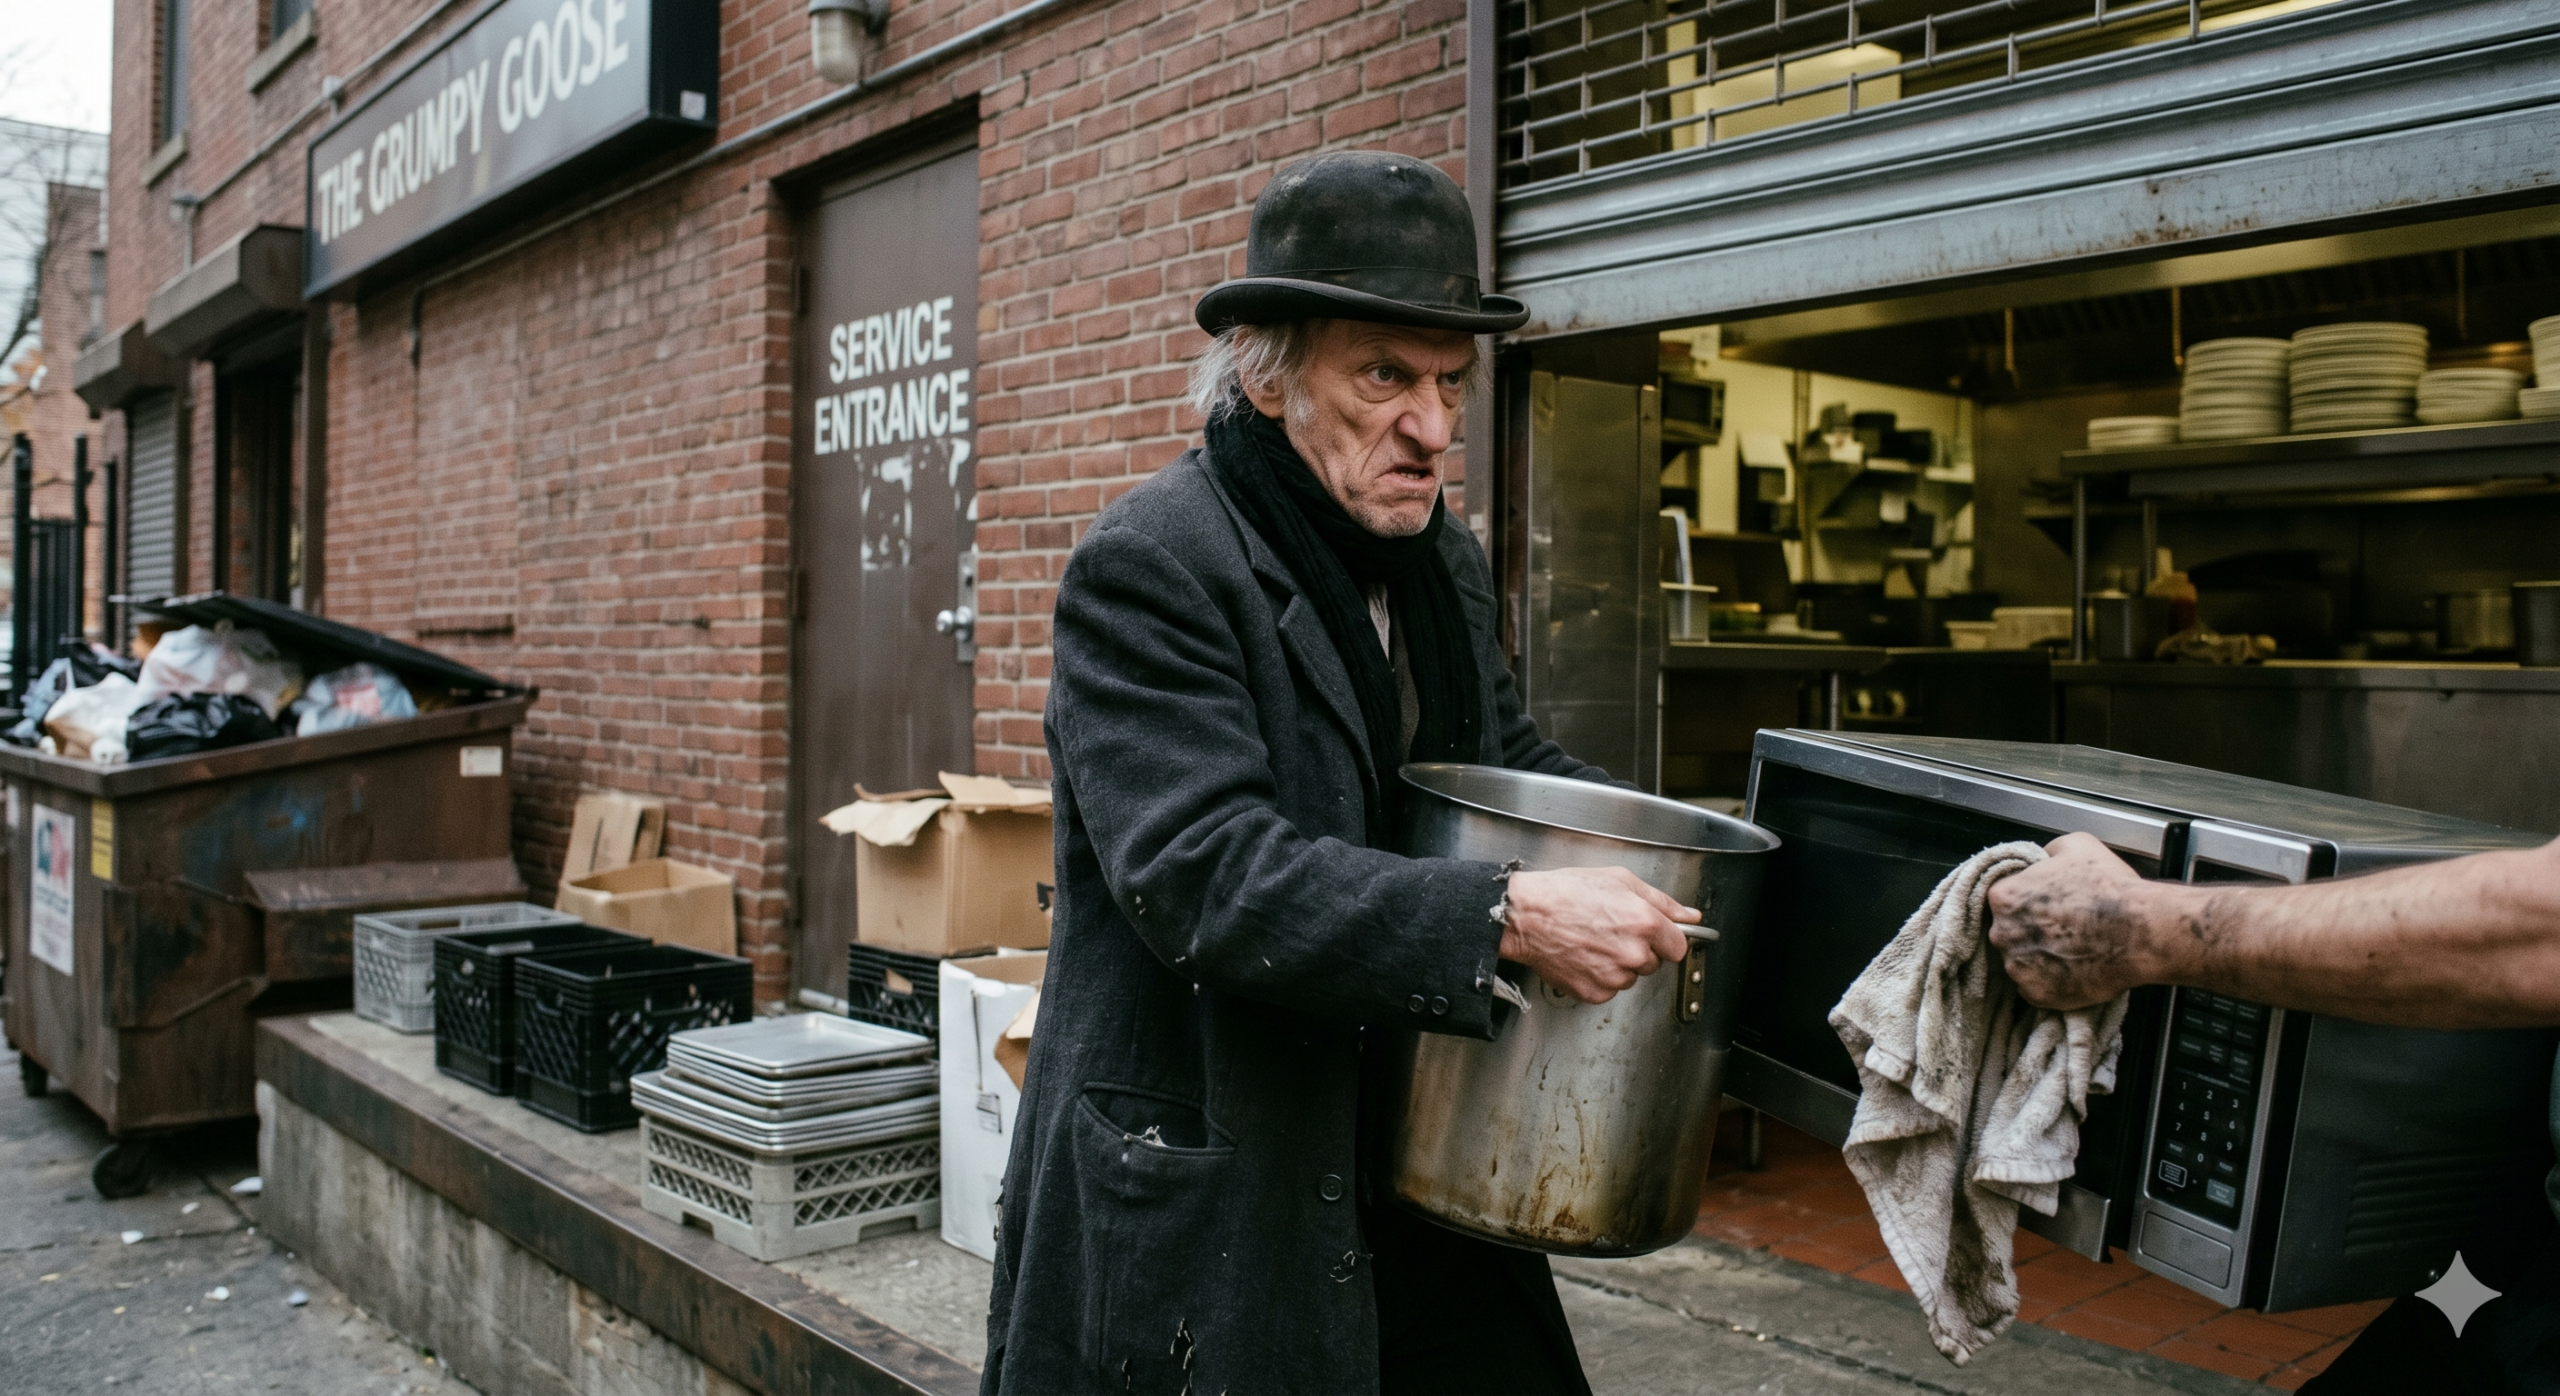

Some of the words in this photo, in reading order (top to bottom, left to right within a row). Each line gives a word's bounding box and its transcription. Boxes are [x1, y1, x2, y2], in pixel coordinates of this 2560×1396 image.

[318, 149, 365, 246] THE
[367, 60, 490, 216] GRUMPY
[498, 0, 629, 135] GOOSE
[829, 295, 954, 384] SERVICE
[814, 368, 970, 456] ENTRANCE
[2182, 1081, 2187, 1090] 1
[2206, 1089, 2213, 1100] 2
[2232, 1098, 2239, 1109] 3
[2178, 1102, 2185, 1111] 4
[2203, 1110, 2210, 1120] 5
[2228, 1120, 2236, 1130] 6
[2175, 1121, 2182, 1132] 7
[2200, 1131, 2207, 1142] 8
[2226, 1141, 2233, 1151] 9
[2197, 1152, 2204, 1163] 0
